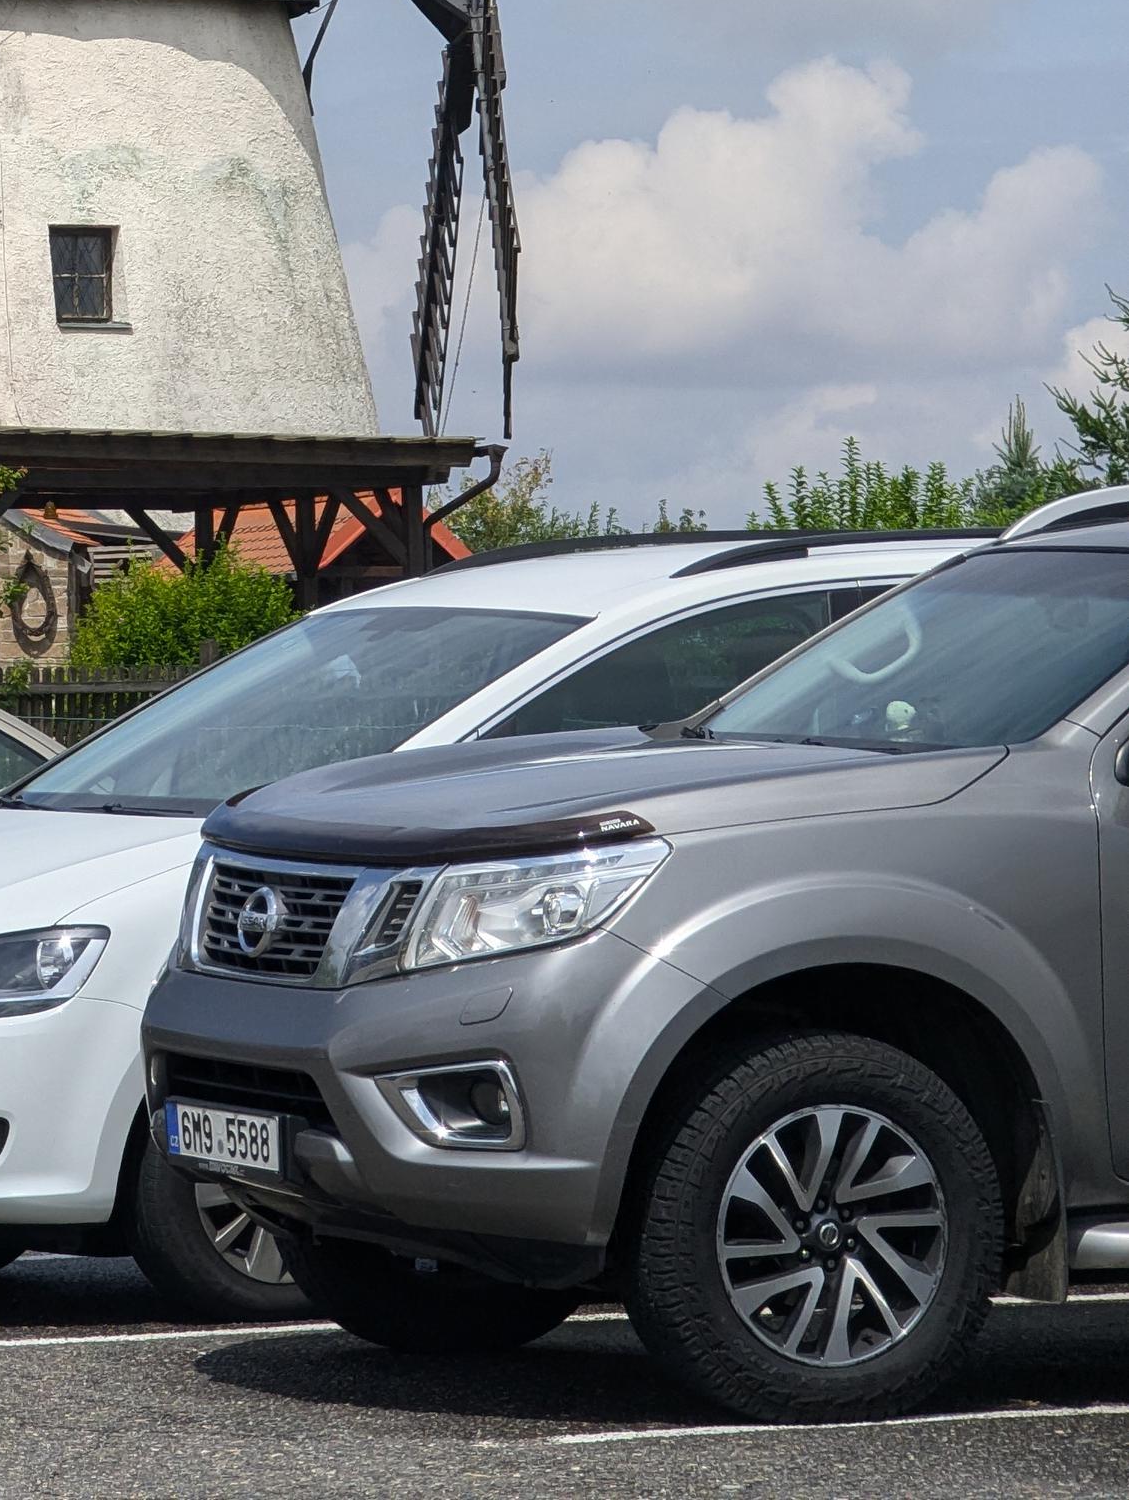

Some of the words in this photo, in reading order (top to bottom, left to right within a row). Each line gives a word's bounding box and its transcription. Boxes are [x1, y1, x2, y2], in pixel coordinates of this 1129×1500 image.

[600, 818, 640, 832] NAVARA
[170, 1134, 180, 1147] CZ
[181, 1110, 214, 1154] 6M9
[225, 1117, 270, 1163] 5588
